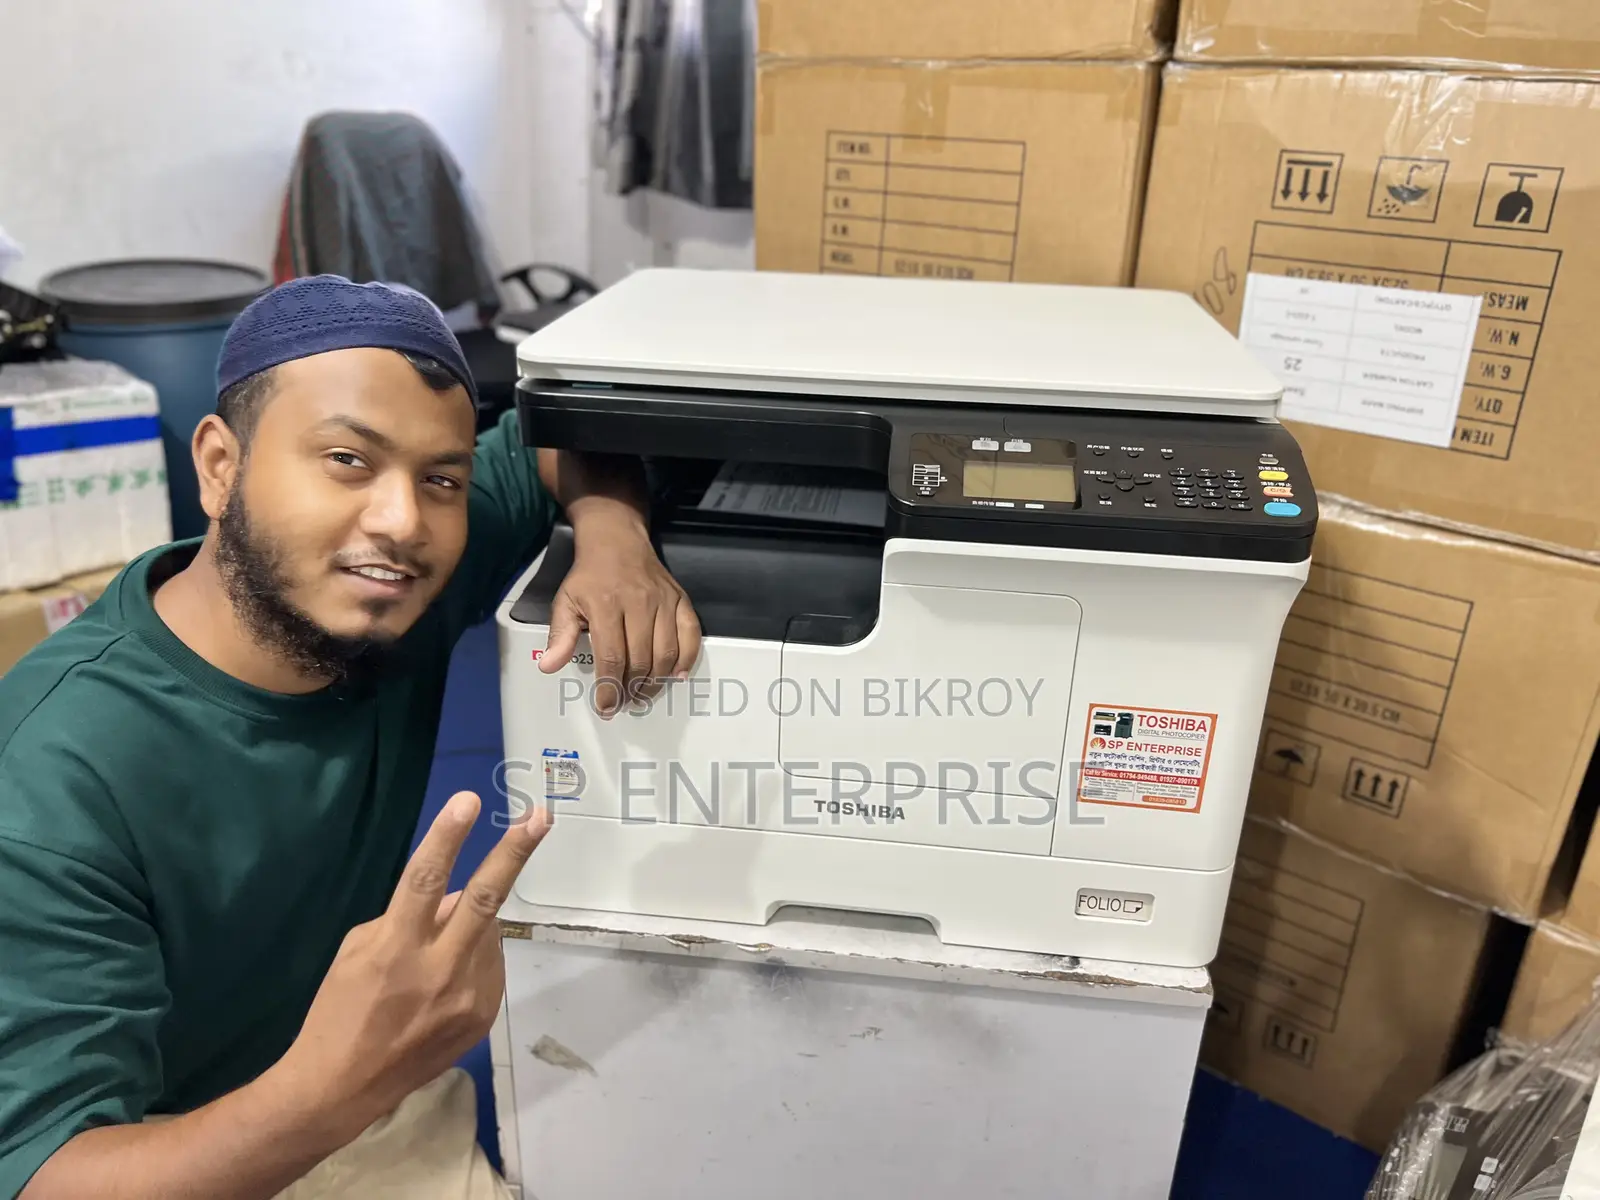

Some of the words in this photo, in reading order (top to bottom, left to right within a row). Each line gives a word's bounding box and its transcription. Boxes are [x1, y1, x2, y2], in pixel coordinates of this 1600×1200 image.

[1283, 356, 1303, 372] 25
[1459, 427, 1495, 447] ITEM
[1136, 714, 1207, 733] TOSHIBA
[1137, 728, 1160, 736] DIGITAL
[1161, 730, 1206, 740] PHOTOCOPIER
[1107, 740, 1124, 750] SP
[1126, 742, 1203, 757] ENTERPRISE
[813, 800, 905, 820] TOSHIBA
[1078, 894, 1122, 912] FOLIO
